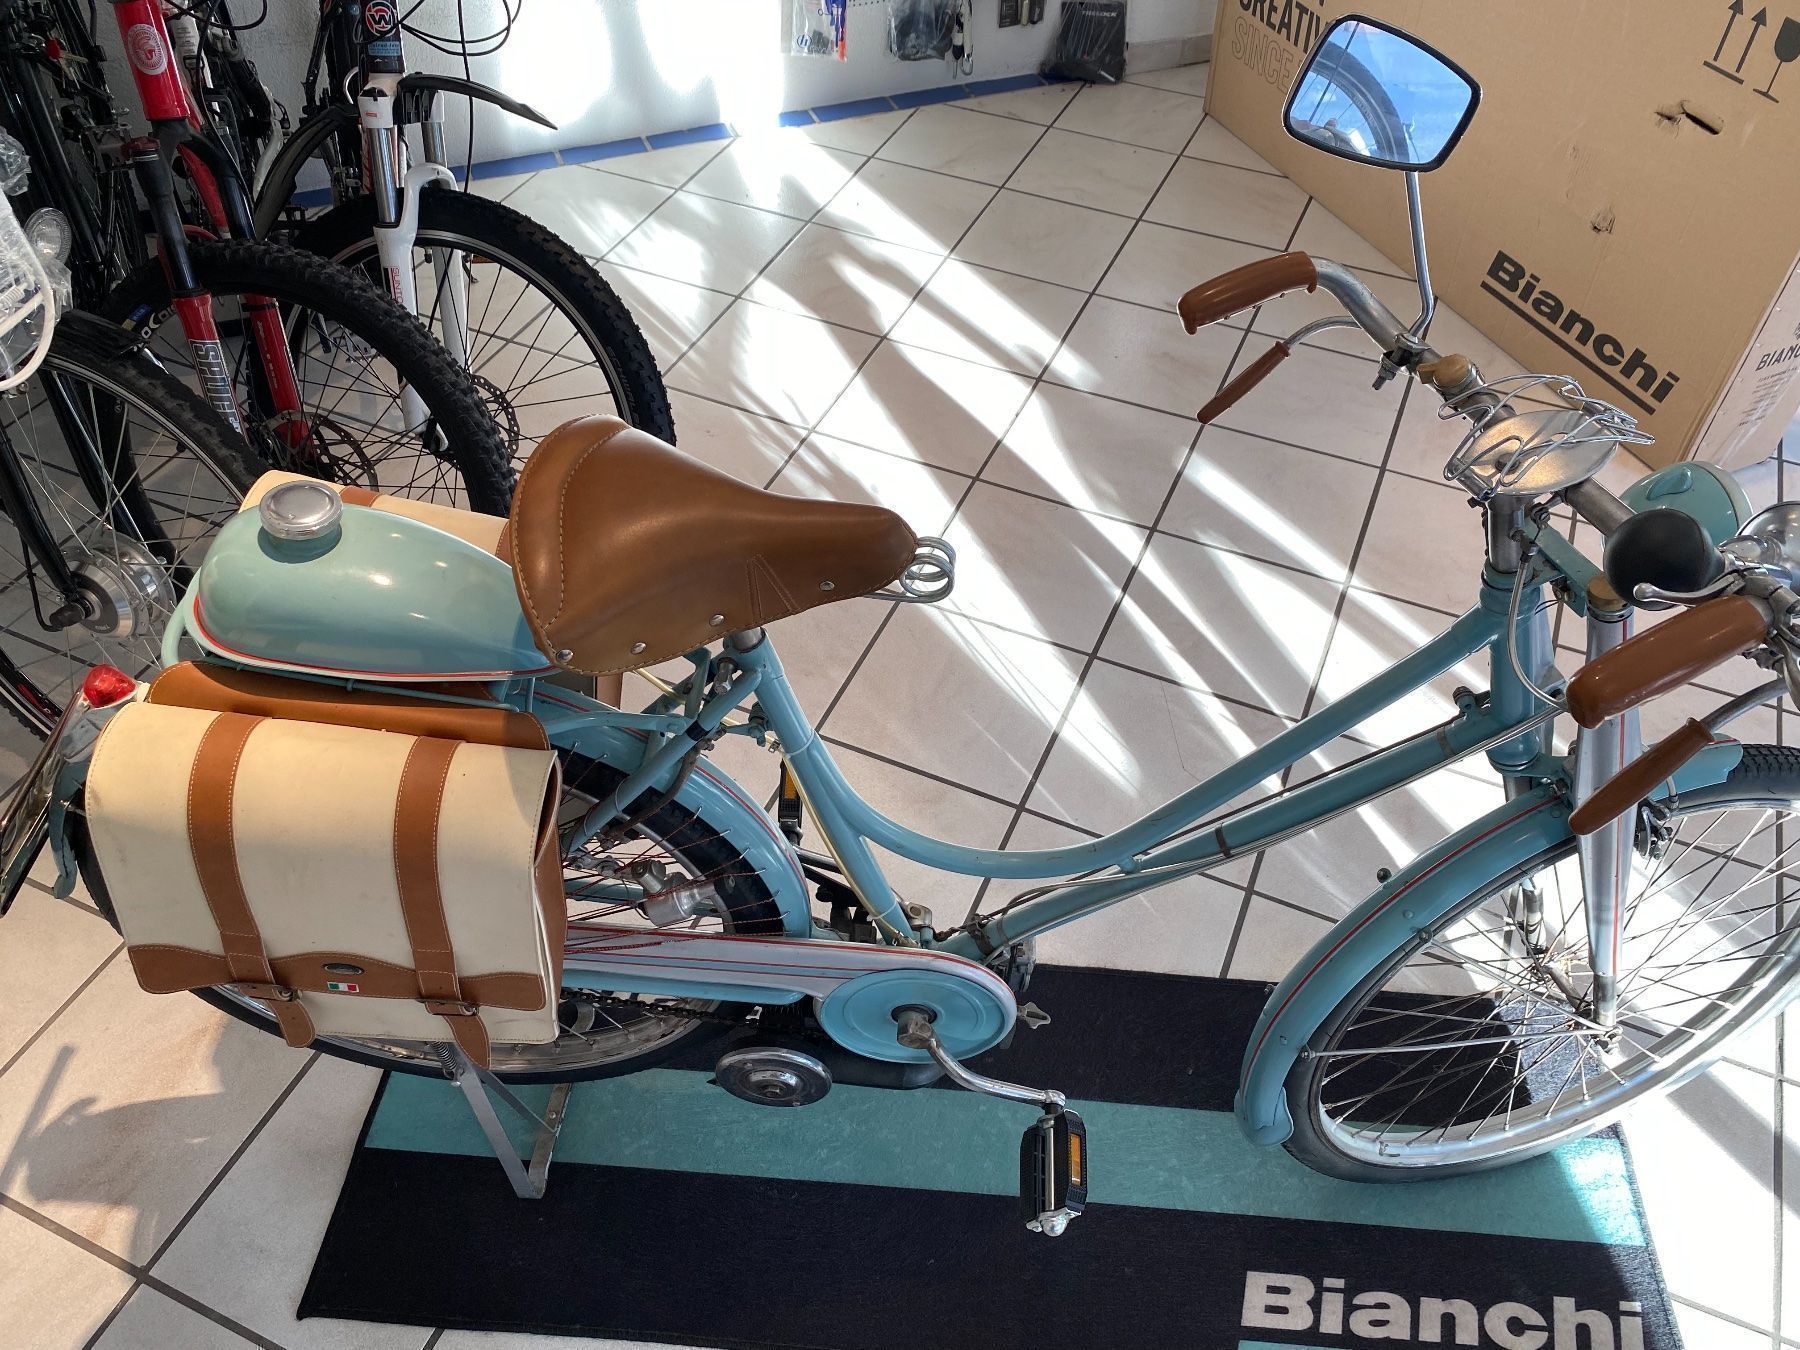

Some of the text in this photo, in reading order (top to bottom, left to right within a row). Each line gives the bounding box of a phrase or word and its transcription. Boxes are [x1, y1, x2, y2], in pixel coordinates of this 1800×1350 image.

[1231, 16, 1294, 96] SINCE
[1486, 250, 1680, 403] Bianchi
[1240, 1270, 1646, 1350] Bianchi
